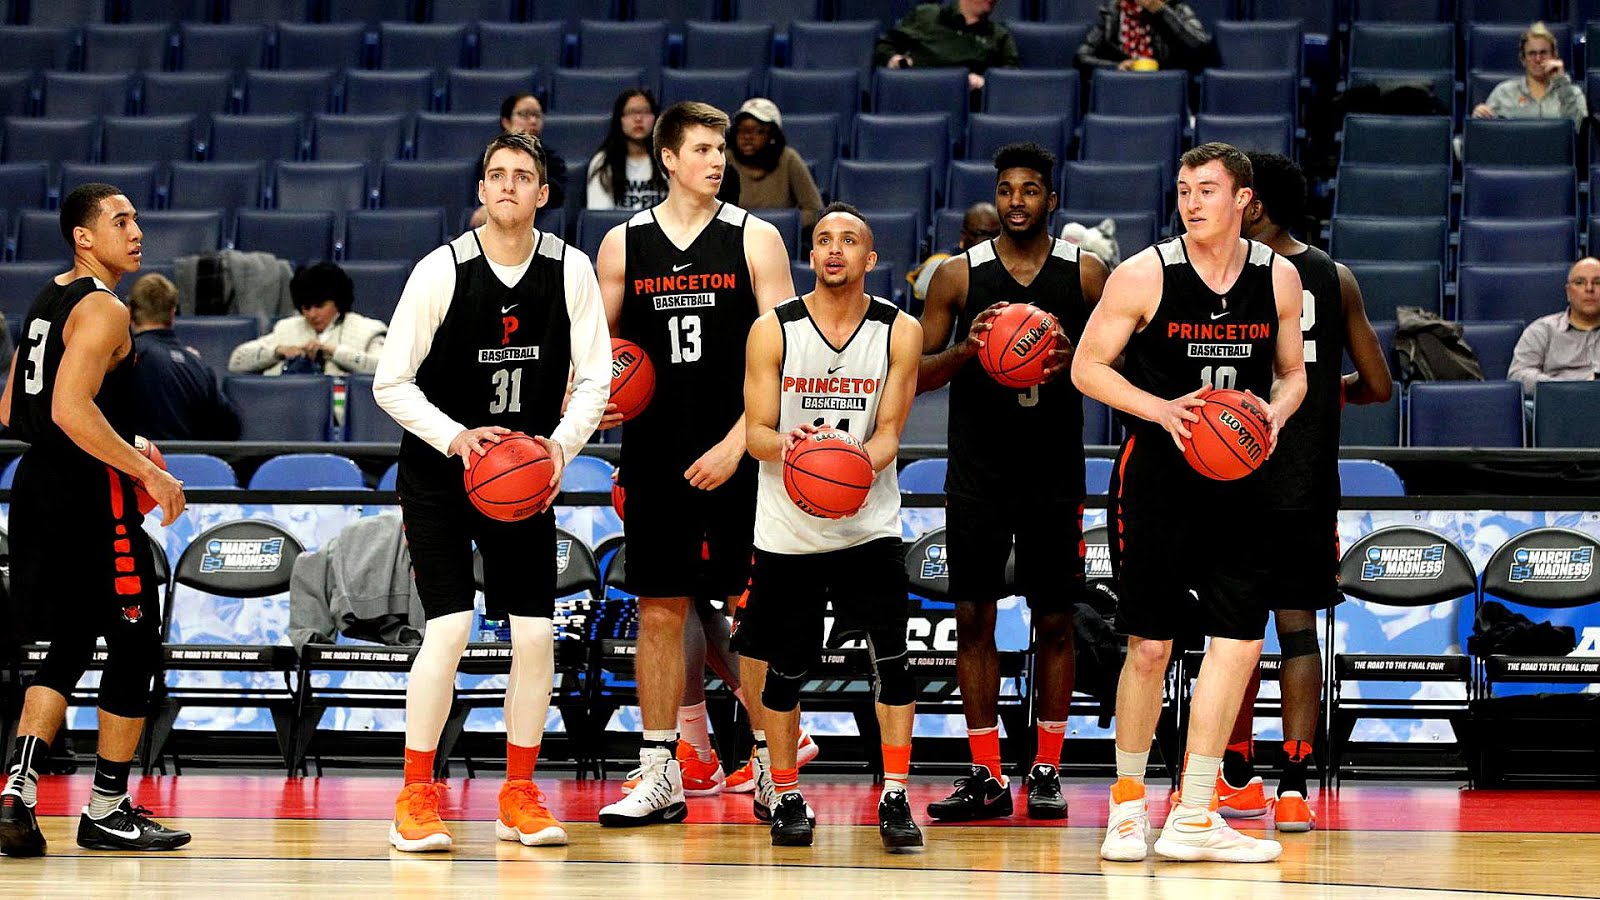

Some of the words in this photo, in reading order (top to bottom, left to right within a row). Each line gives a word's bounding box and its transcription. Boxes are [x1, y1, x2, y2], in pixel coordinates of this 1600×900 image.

[634, 273, 736, 295] PRINCETON
[655, 295, 712, 308] BASKETBALL
[502, 315, 519, 345] P
[1167, 322, 1271, 340] PRINCETON
[668, 315, 702, 364] 13
[25, 317, 51, 395] 3
[1190, 345, 1249, 357] BASKETBALL
[489, 368, 523, 414] 31
[804, 397, 864, 409] BASKETBALL
[1219, 409, 1262, 463] Wilson
[220, 542, 262, 555] MARCH
[224, 554, 281, 567] MADNESS
[1380, 549, 1423, 562] MARCH
[1528, 551, 1571, 563] MARCH
[1385, 561, 1443, 574] MADNESS
[1533, 563, 1591, 576] MADNESS
[202, 650, 211, 659] TO
[351, 651, 360, 660] TO
[488, 649, 498, 657] TO
[614, 646, 627, 654] THE
[827, 655, 846, 664] FOUR
[917, 658, 935, 666] ROAD
[935, 658, 945, 666] TO
[945, 658, 957, 666] THE
[1259, 660, 1278, 669] FINAL
[1354, 661, 1367, 670] THE
[1367, 661, 1385, 670] ROAD
[1385, 661, 1394, 670] TO
[1395, 661, 1408, 670] THE
[1407, 662, 1426, 671] FINAL
[1426, 662, 1445, 671] FOUR
[1507, 663, 1520, 671] THE
[1520, 663, 1538, 671] ROAD
[1538, 663, 1547, 671] TO
[1548, 663, 1561, 672] THE
[1561, 664, 1579, 672] FINAL
